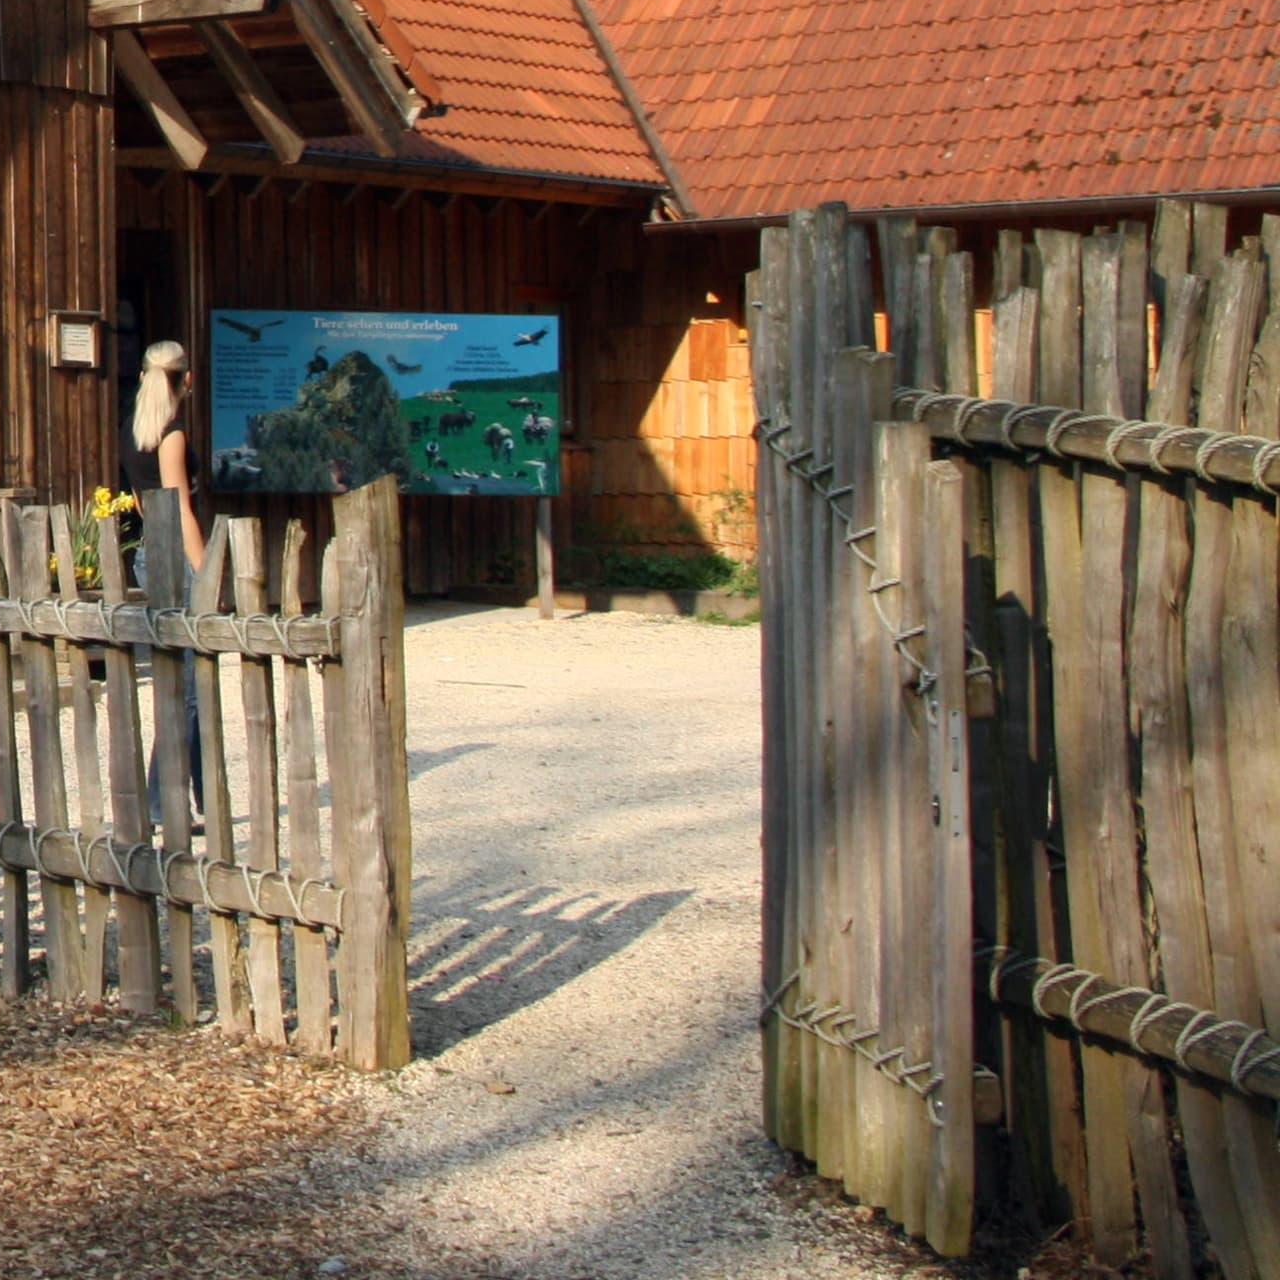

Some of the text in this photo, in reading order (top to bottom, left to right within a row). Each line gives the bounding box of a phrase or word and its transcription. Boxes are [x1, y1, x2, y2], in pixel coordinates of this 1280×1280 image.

[312, 316, 459, 331] Tiere sehen und erleben
